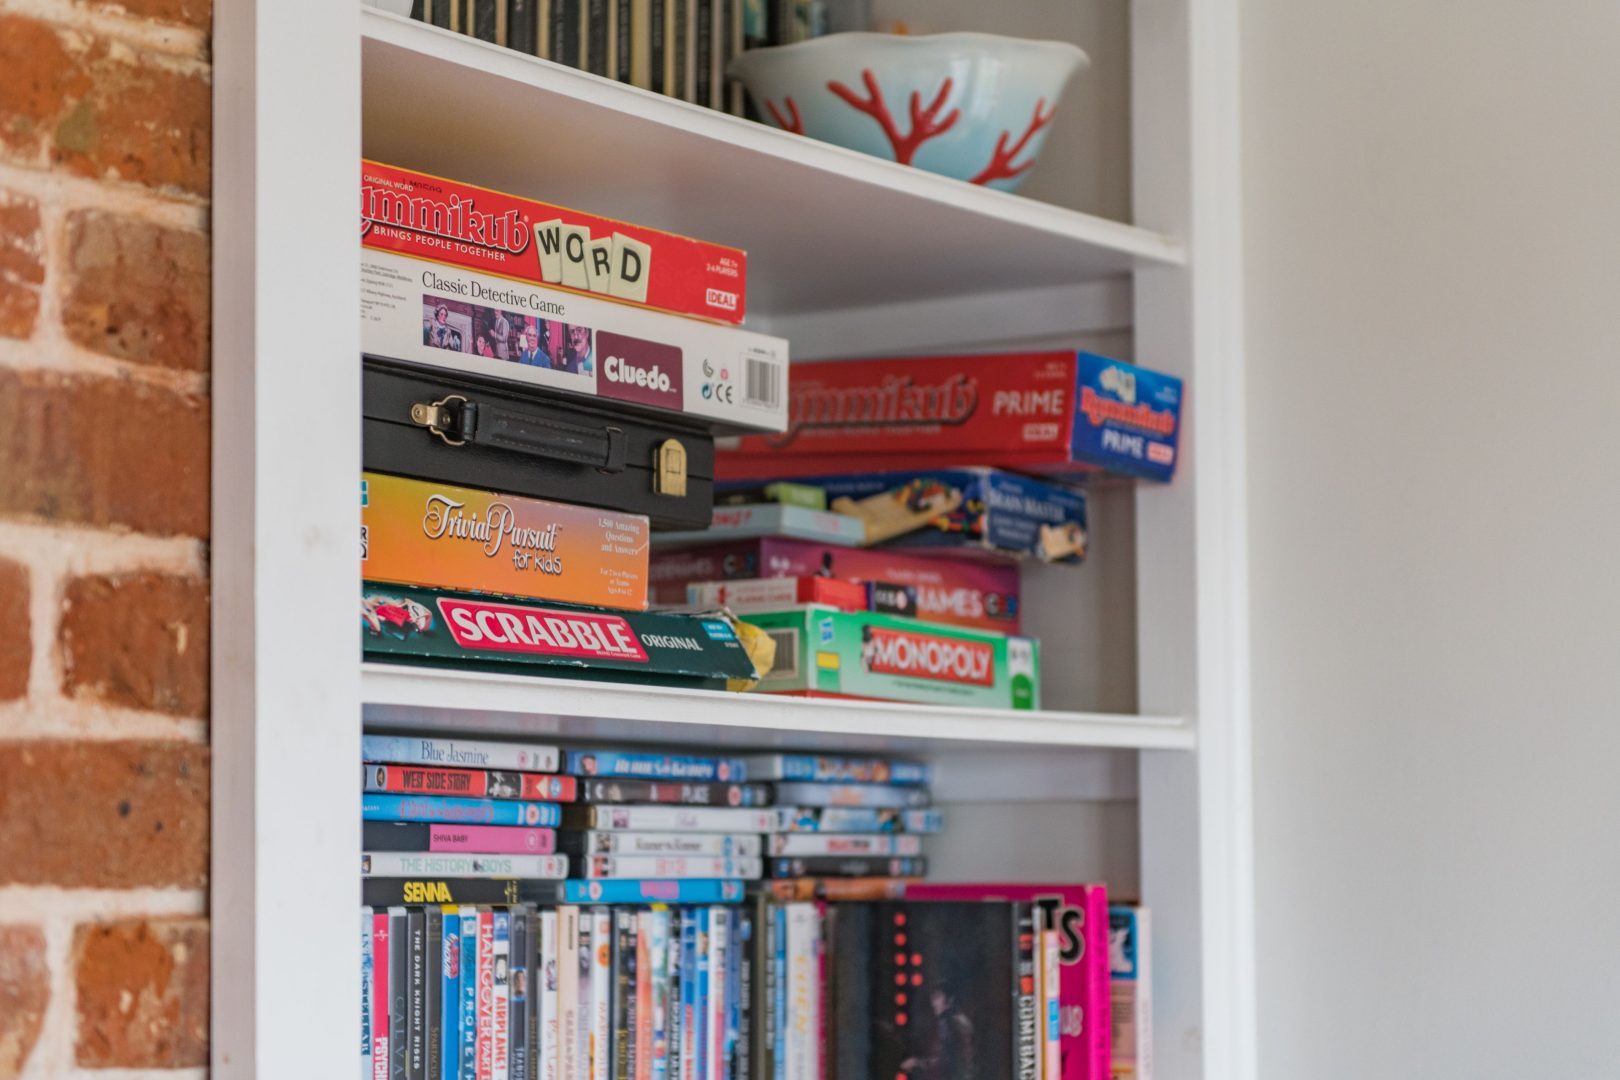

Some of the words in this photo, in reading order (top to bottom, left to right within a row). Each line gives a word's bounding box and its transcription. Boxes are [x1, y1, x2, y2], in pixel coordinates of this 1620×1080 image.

[363, 174, 393, 188] ORIGINAL
[393, 181, 414, 192] WORD
[361, 185, 530, 254] ummikub
[373, 226, 412, 242] BRINGS
[415, 234, 452, 250] PEOPLE
[455, 243, 506, 262] TOGETHER
[538, 227, 641, 283] WORD
[422, 271, 468, 296] Classic
[471, 280, 527, 308] Detective
[529, 294, 565, 316] Game
[708, 290, 735, 308] IDEAL
[604, 356, 670, 392] Cluedo
[992, 389, 1065, 415] PRIME
[423, 494, 491, 542] Trivial
[484, 502, 558, 556] Pursuit
[605, 530, 635, 544] Questions
[615, 521, 640, 535] Amazing
[512, 550, 531, 571] for
[534, 553, 563, 576] kids
[451, 607, 638, 653] SCRABBLE
[641, 633, 704, 652] ORIGINAL
[874, 637, 991, 680] MONOPOLY
[421, 740, 445, 761] Blue
[447, 743, 490, 765] Jasmine
[402, 770, 425, 789] WEST
[426, 772, 446, 790] SIDE
[447, 772, 472, 791] STORY
[433, 834, 452, 842] SHIVA
[452, 834, 469, 843] BABY
[401, 858, 422, 872] THE
[424, 859, 471, 873] HISTORY
[482, 859, 513, 873] BOYS
[403, 881, 453, 903] SENNA
[480, 924, 493, 1037] HANGOVER
[495, 996, 506, 1070] AIRPLANE!
[413, 1035, 421, 1070] RISES
[481, 1041, 491, 1071] PART
